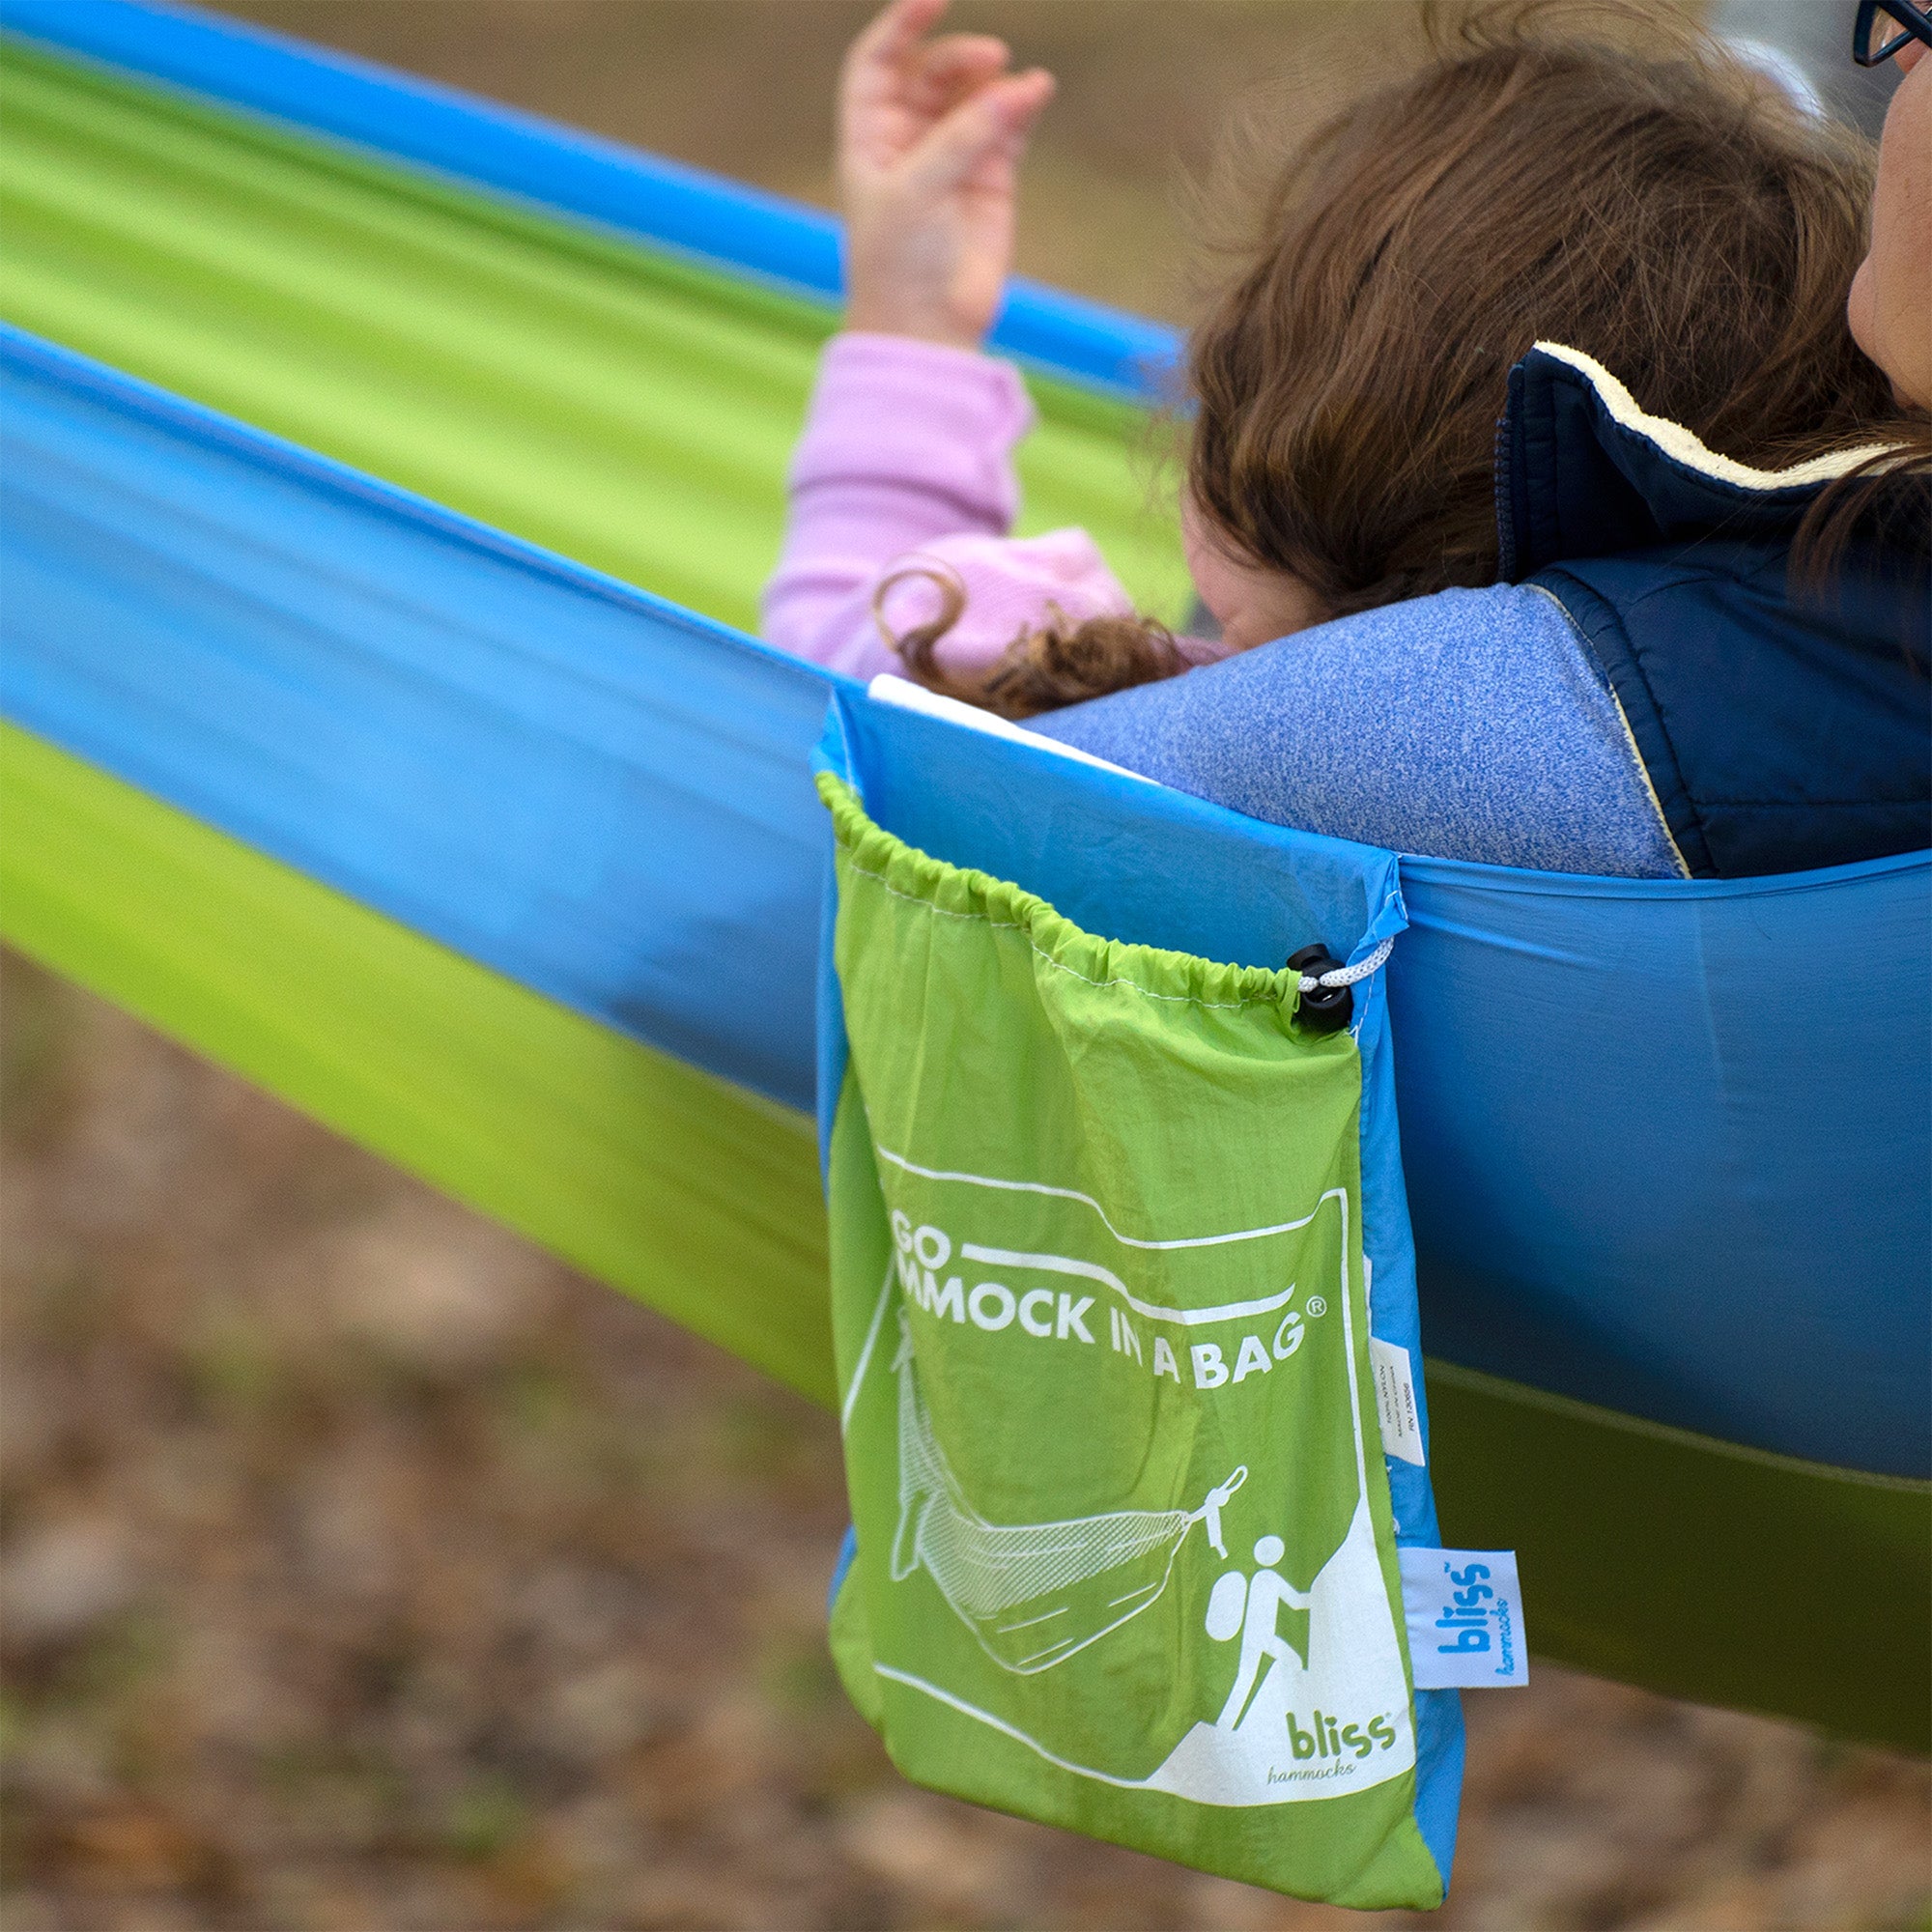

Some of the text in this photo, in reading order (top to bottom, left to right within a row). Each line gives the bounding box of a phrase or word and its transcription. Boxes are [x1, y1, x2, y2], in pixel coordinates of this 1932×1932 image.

[891, 1209, 952, 1270] GO
[1111, 1307, 1143, 1367] IN
[1153, 1337, 1180, 1384] A
[1407, 1416, 1415, 1432] RN
[1490, 1598, 1515, 1677] hammocks
[1286, 1709, 1396, 1759] bliss
[1266, 1756, 1357, 1785] hammocks
